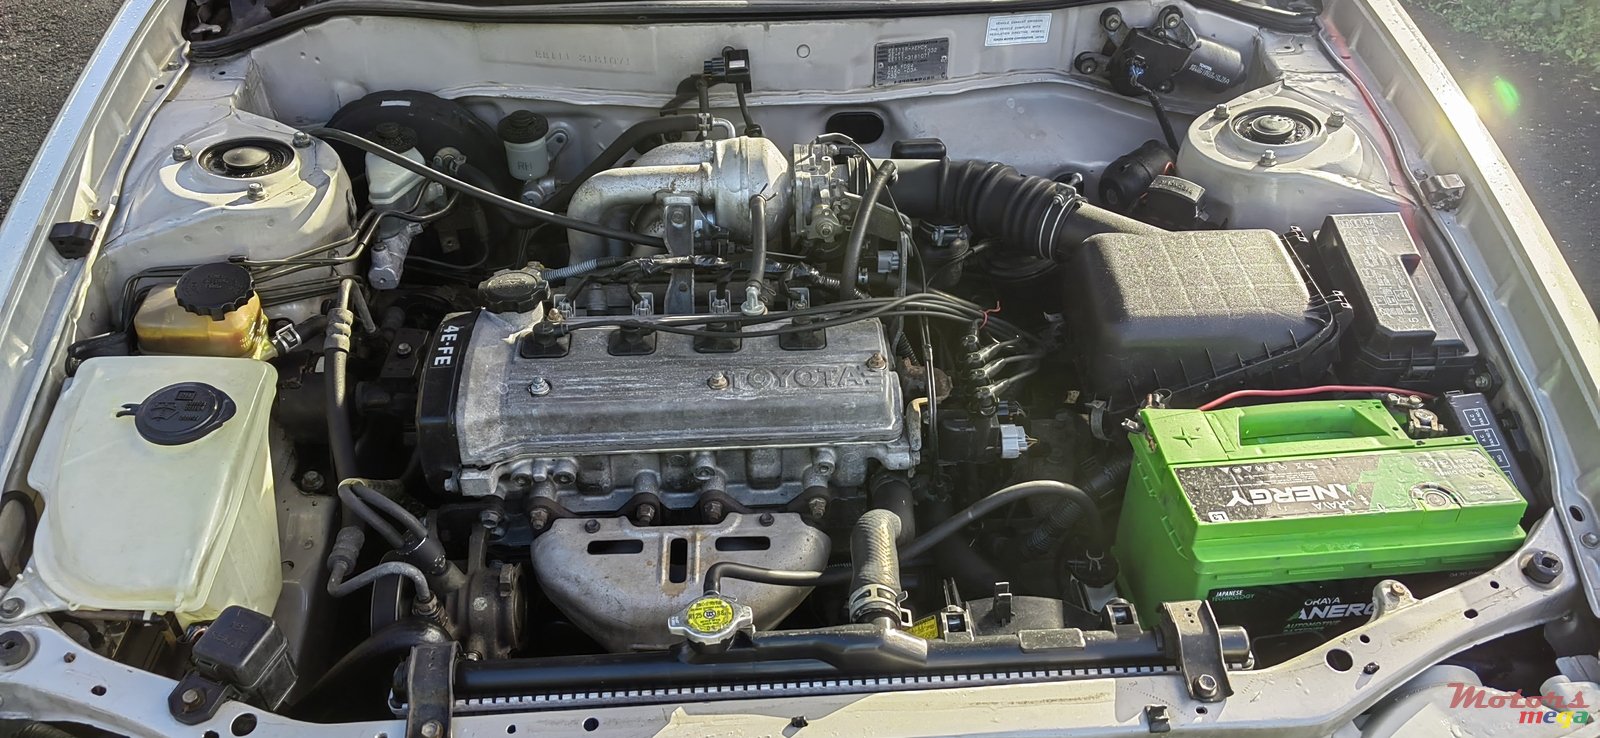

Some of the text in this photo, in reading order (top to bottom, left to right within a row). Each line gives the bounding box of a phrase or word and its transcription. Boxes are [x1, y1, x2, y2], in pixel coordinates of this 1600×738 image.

[729, 365, 867, 390] TOYOTA
[1226, 483, 1354, 507] ANERGY
[1211, 593, 1255, 603] TECHNOLOGY
[1215, 589, 1244, 598] JAPANESE
[1304, 597, 1341, 606] OKAYA
